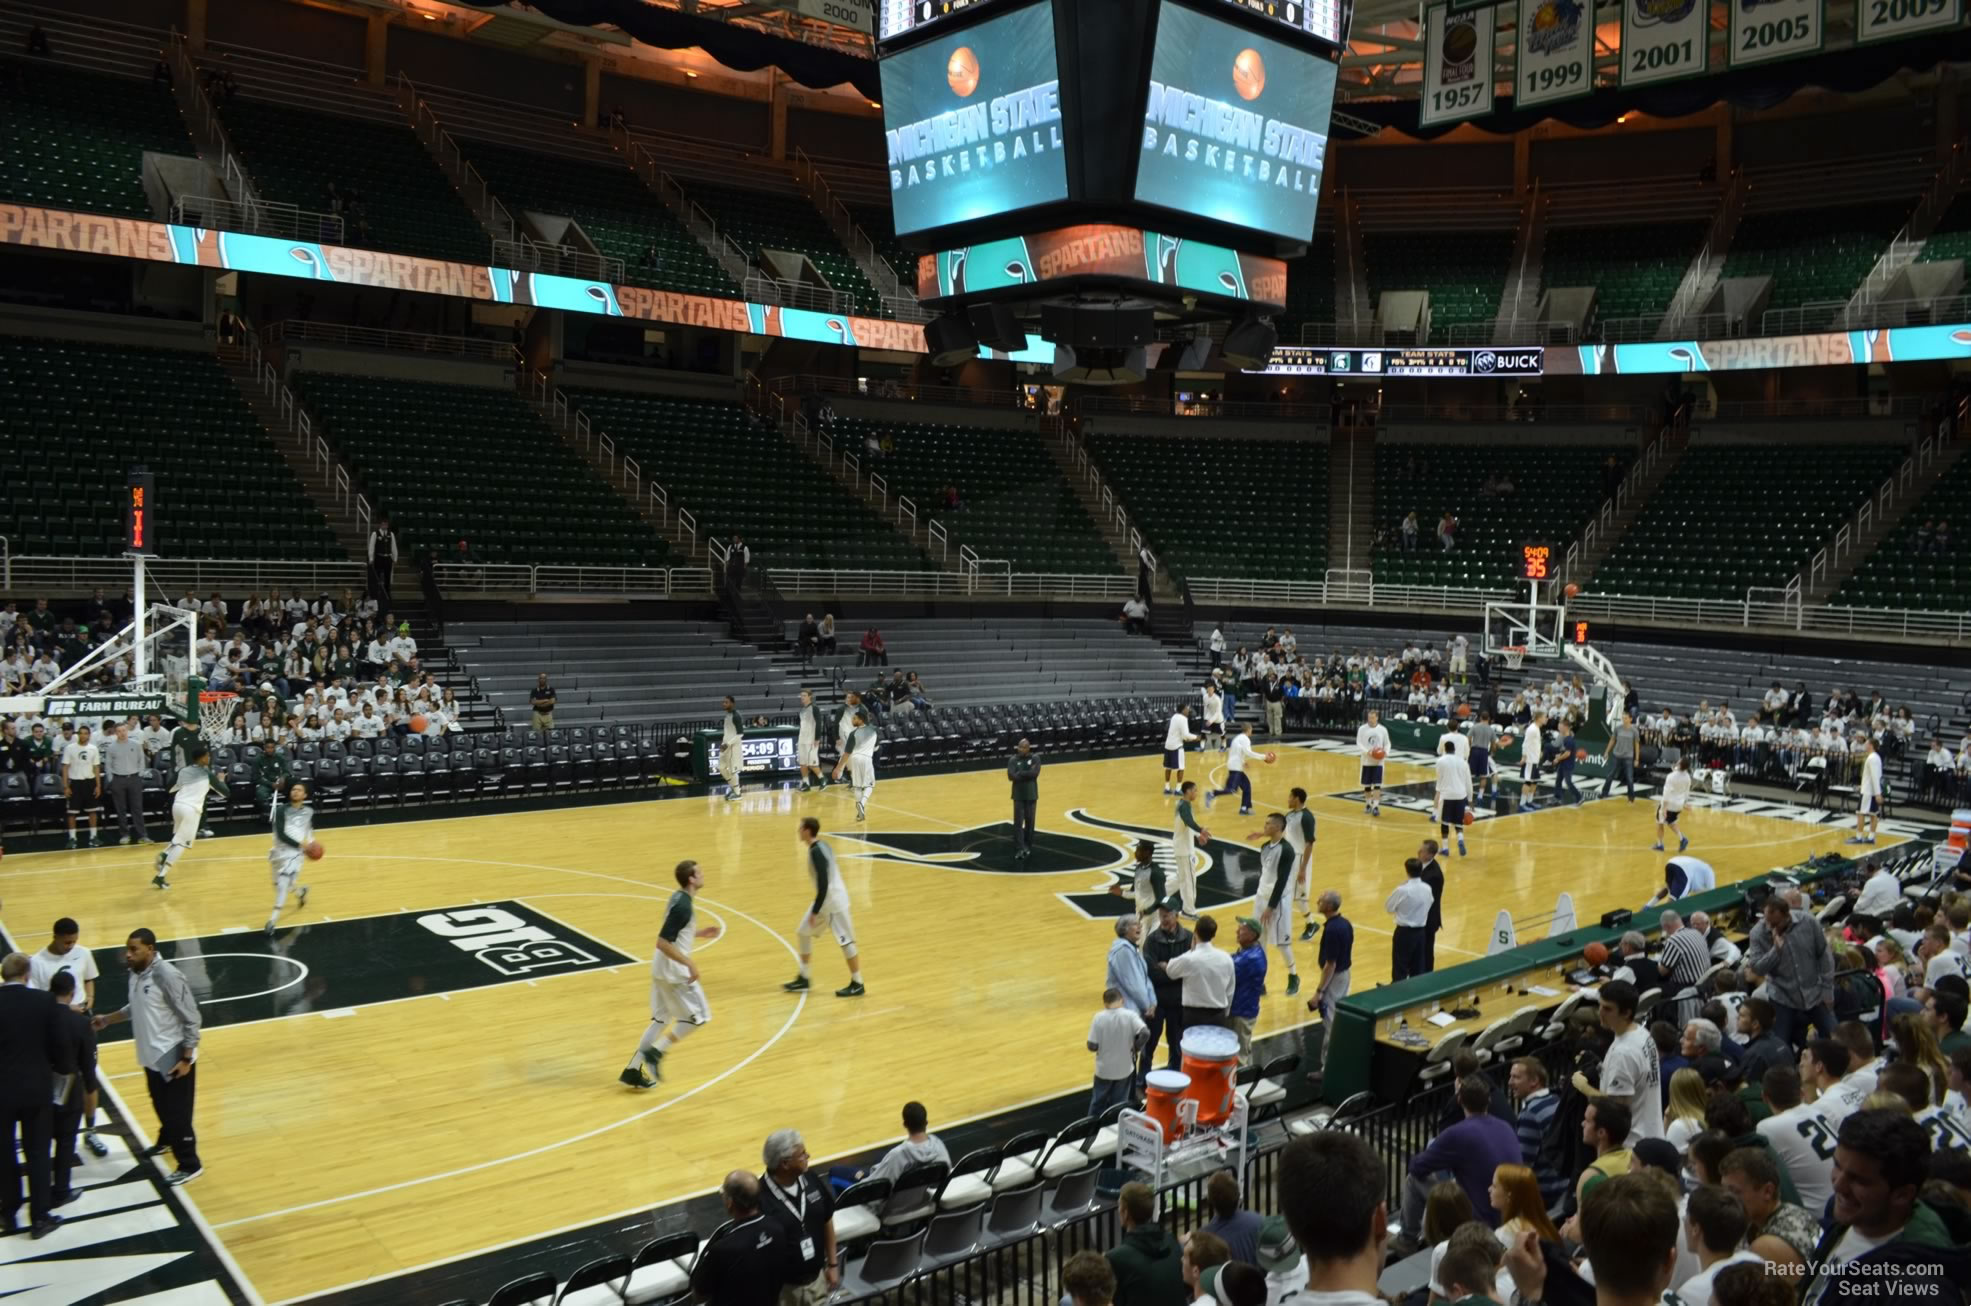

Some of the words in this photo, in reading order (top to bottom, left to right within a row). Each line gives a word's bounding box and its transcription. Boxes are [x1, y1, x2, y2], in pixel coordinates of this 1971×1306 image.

[824, 3, 858, 24] 2000
[1742, 16, 1809, 51] 2005
[1631, 40, 1692, 72] 2001
[1527, 62, 1582, 93] 1999
[1432, 82, 1484, 112] 1957
[886, 102, 989, 166] MICHIGAN
[990, 80, 1062, 136] STATE
[1146, 80, 1263, 152] MICHIGAN
[1263, 118, 1327, 170] STATE
[891, 126, 1062, 190] BASKETBALL
[1143, 126, 1318, 196] BASKETBALL
[1039, 230, 1142, 280] SPARTANS
[330, 248, 492, 299] SPARTANS
[617, 288, 748, 332] SPARTANS
[1497, 356, 1538, 368] BUICK
[1703, 332, 1850, 371] SPARTANS
[1526, 558, 1546, 577] 35
[79, 702, 111, 712] FARM
[113, 700, 162, 711] BUREAU
[742, 742, 774, 756] 54:09
[1499, 930, 1509, 944] S
[1125, 1128, 1154, 1146] GATORADE
